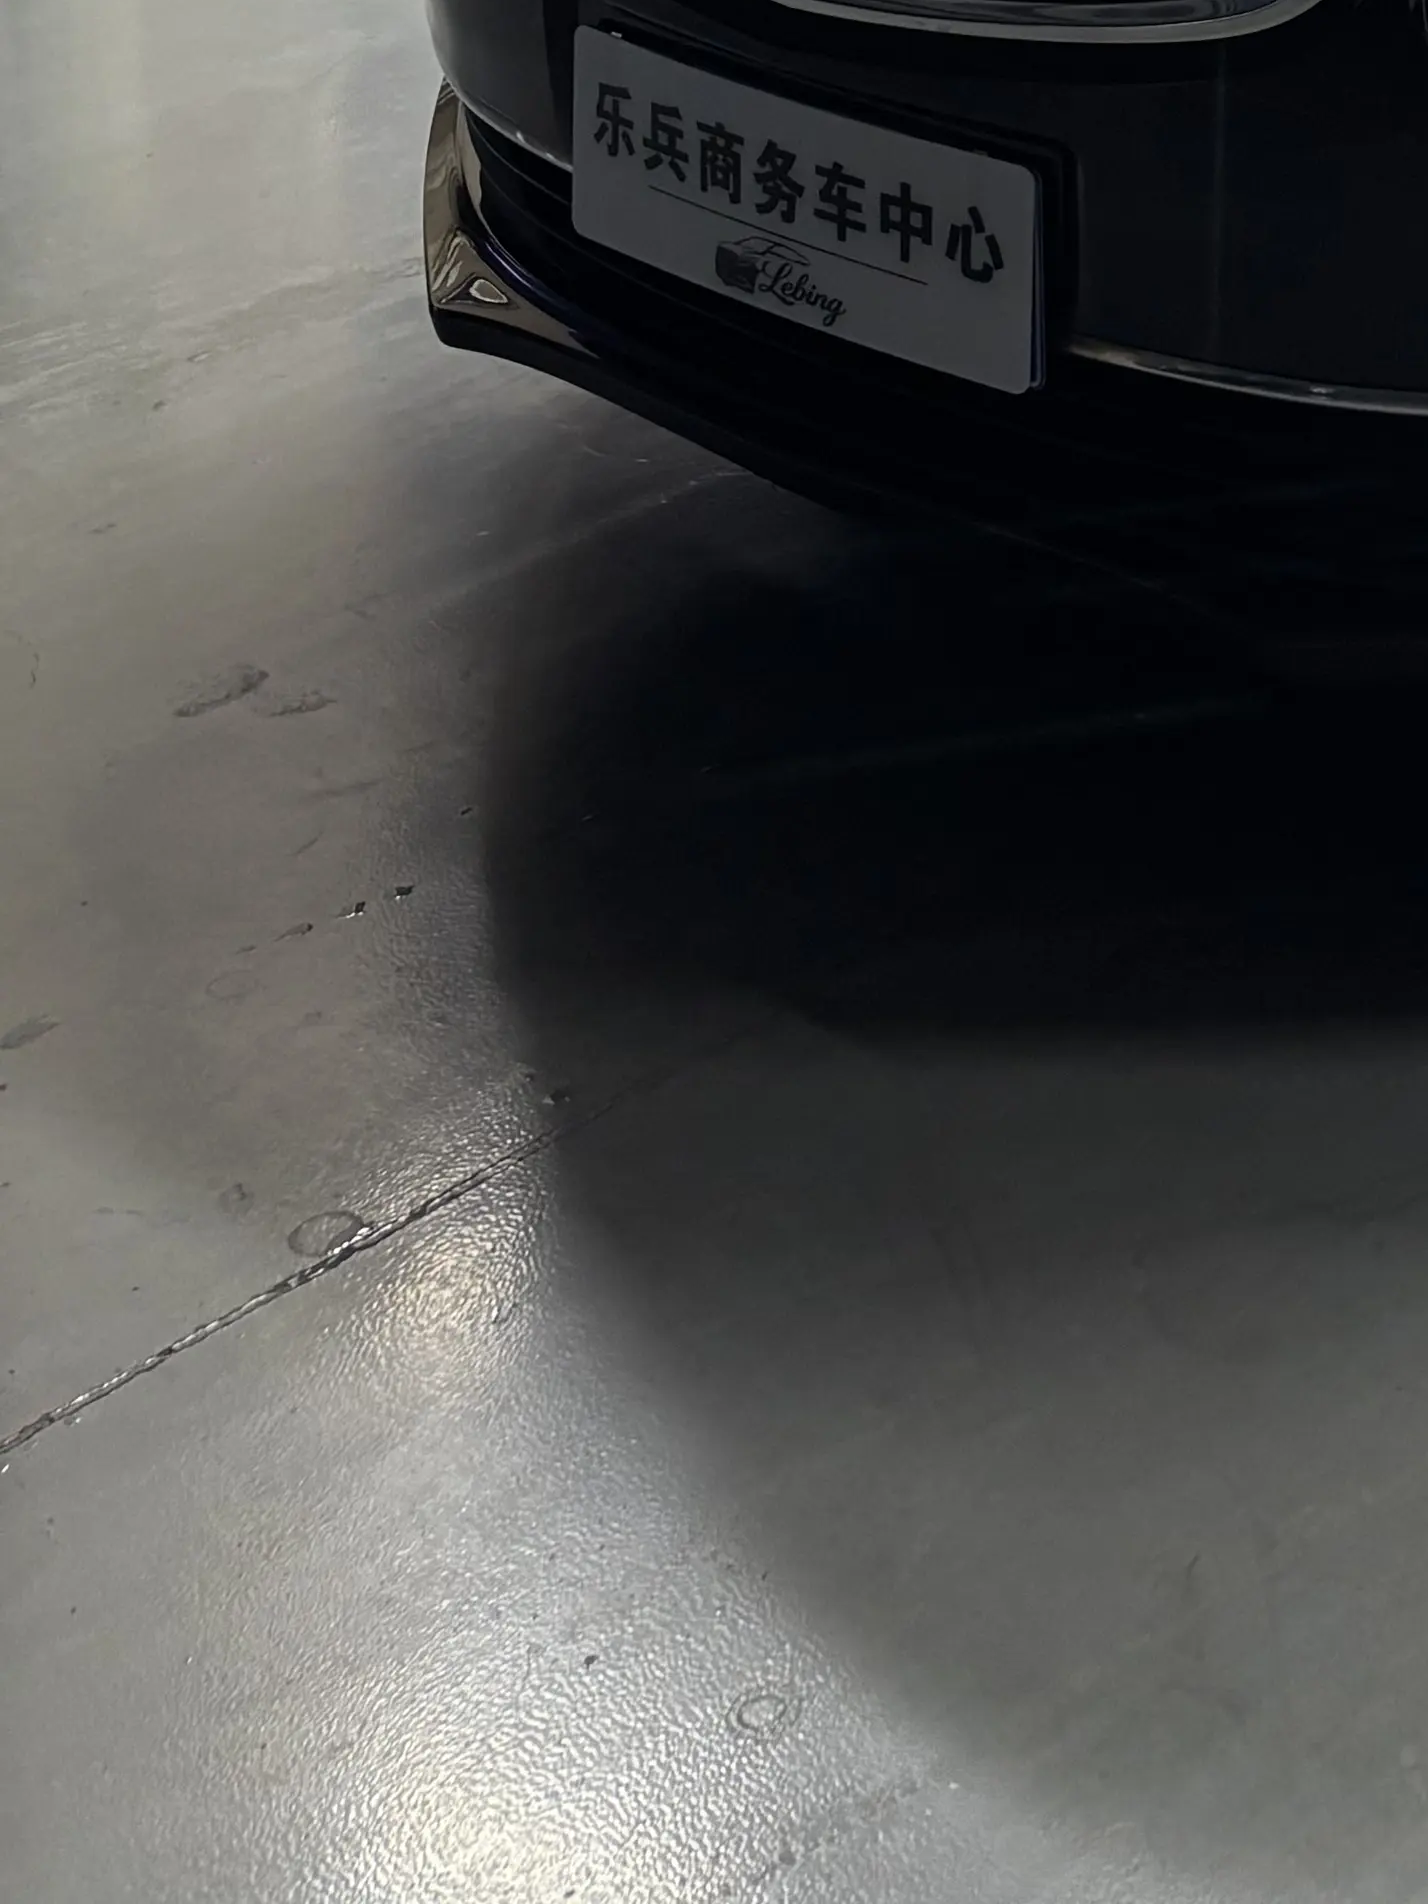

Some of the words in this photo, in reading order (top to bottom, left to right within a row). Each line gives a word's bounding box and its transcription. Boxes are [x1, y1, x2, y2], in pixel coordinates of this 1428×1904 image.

[594, 81, 1004, 283] 乐兵商务车中心
[758, 259, 846, 327] Lebing
